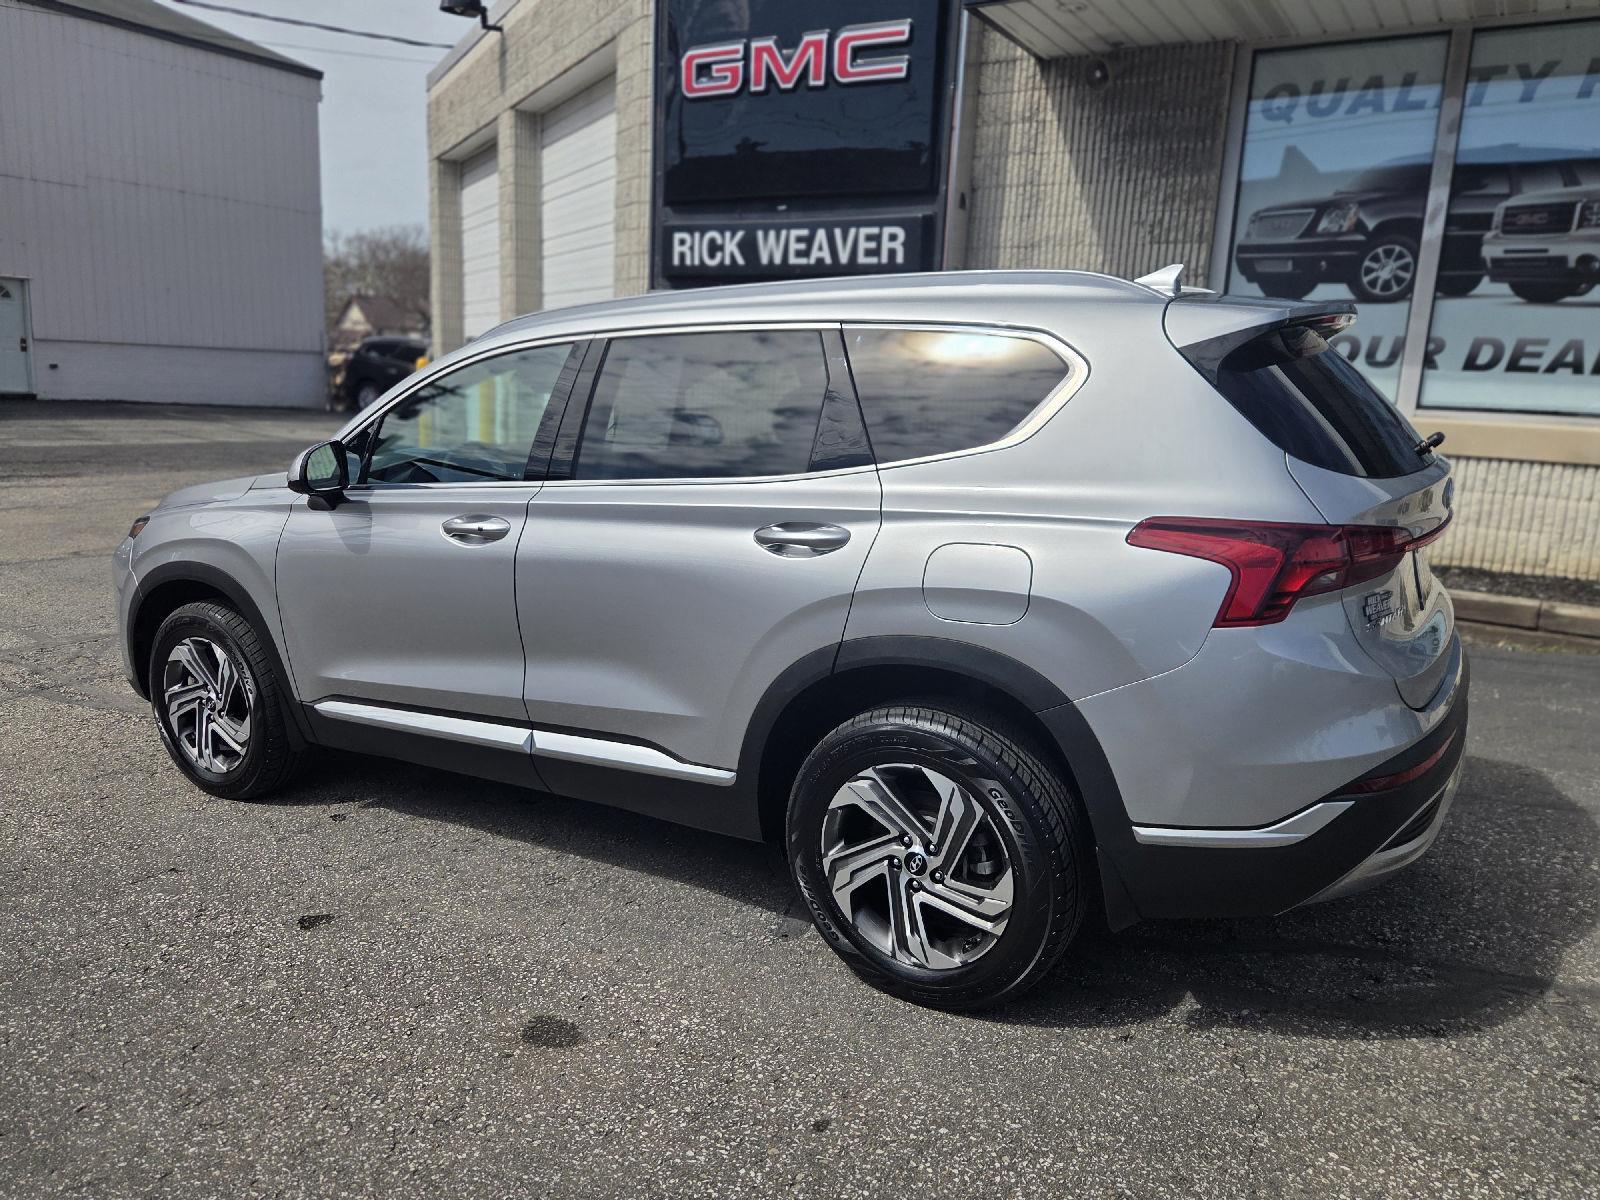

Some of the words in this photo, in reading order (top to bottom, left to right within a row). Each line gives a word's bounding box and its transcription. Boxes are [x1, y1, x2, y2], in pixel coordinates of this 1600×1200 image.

[682, 19, 912, 98] GMC
[1260, 59, 1560, 124] QUALTY
[672, 230, 746, 267] RICK
[756, 226, 906, 266] WEAVER
[1461, 337, 1600, 376] DEA
